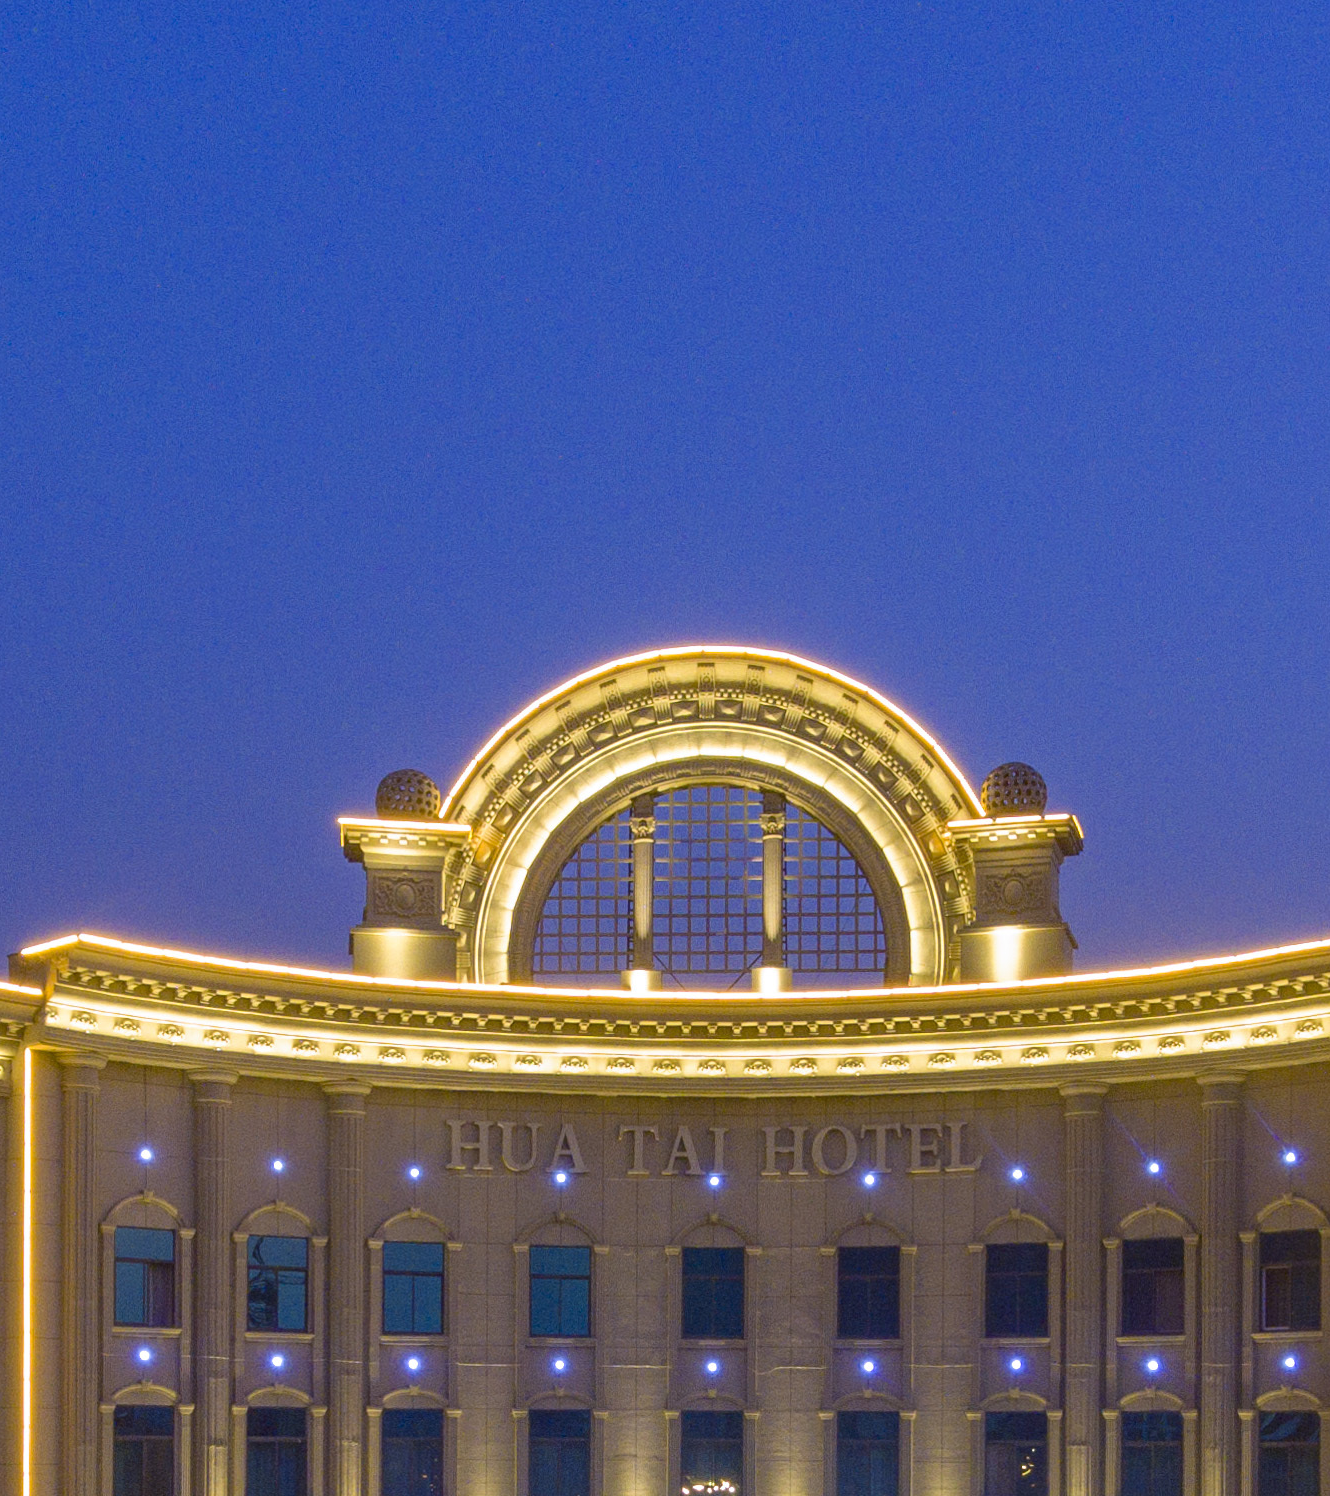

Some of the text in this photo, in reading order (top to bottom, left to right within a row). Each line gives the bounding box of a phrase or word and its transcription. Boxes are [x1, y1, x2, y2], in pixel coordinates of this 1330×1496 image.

[445, 1119, 983, 1176] HUA TAI HOTEL
